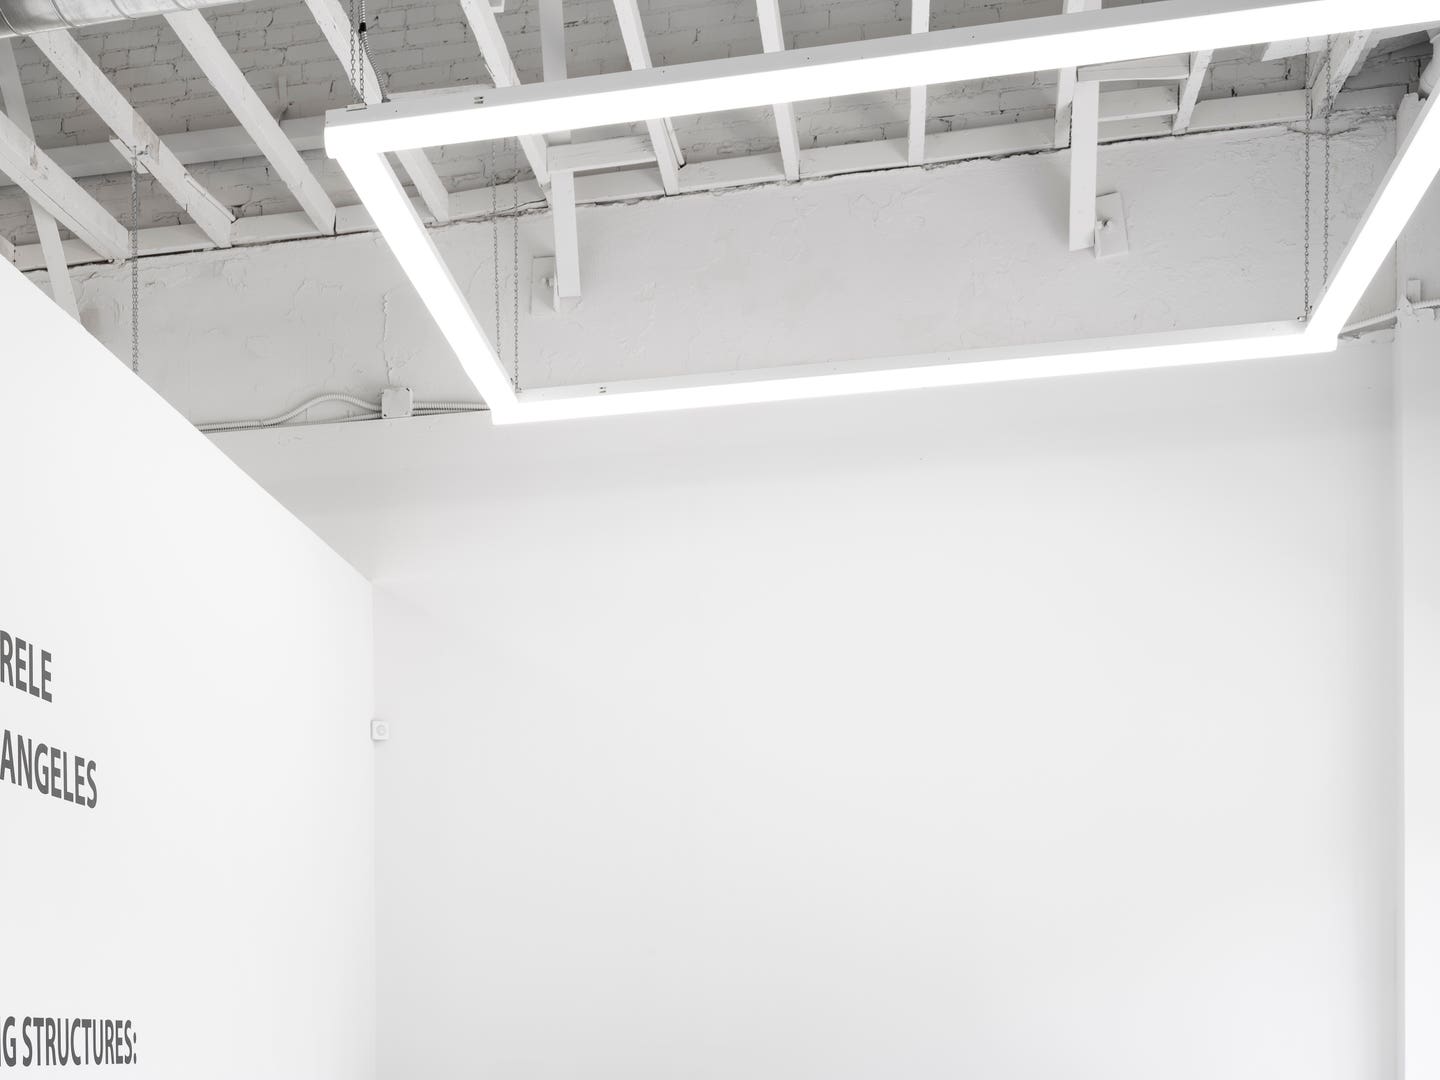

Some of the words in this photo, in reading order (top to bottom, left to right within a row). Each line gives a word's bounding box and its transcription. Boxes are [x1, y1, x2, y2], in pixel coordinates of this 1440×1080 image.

[0, 629, 53, 703] RELE
[0, 728, 98, 809] ANGELES
[22, 1016, 137, 1067] STRUCTURES:
